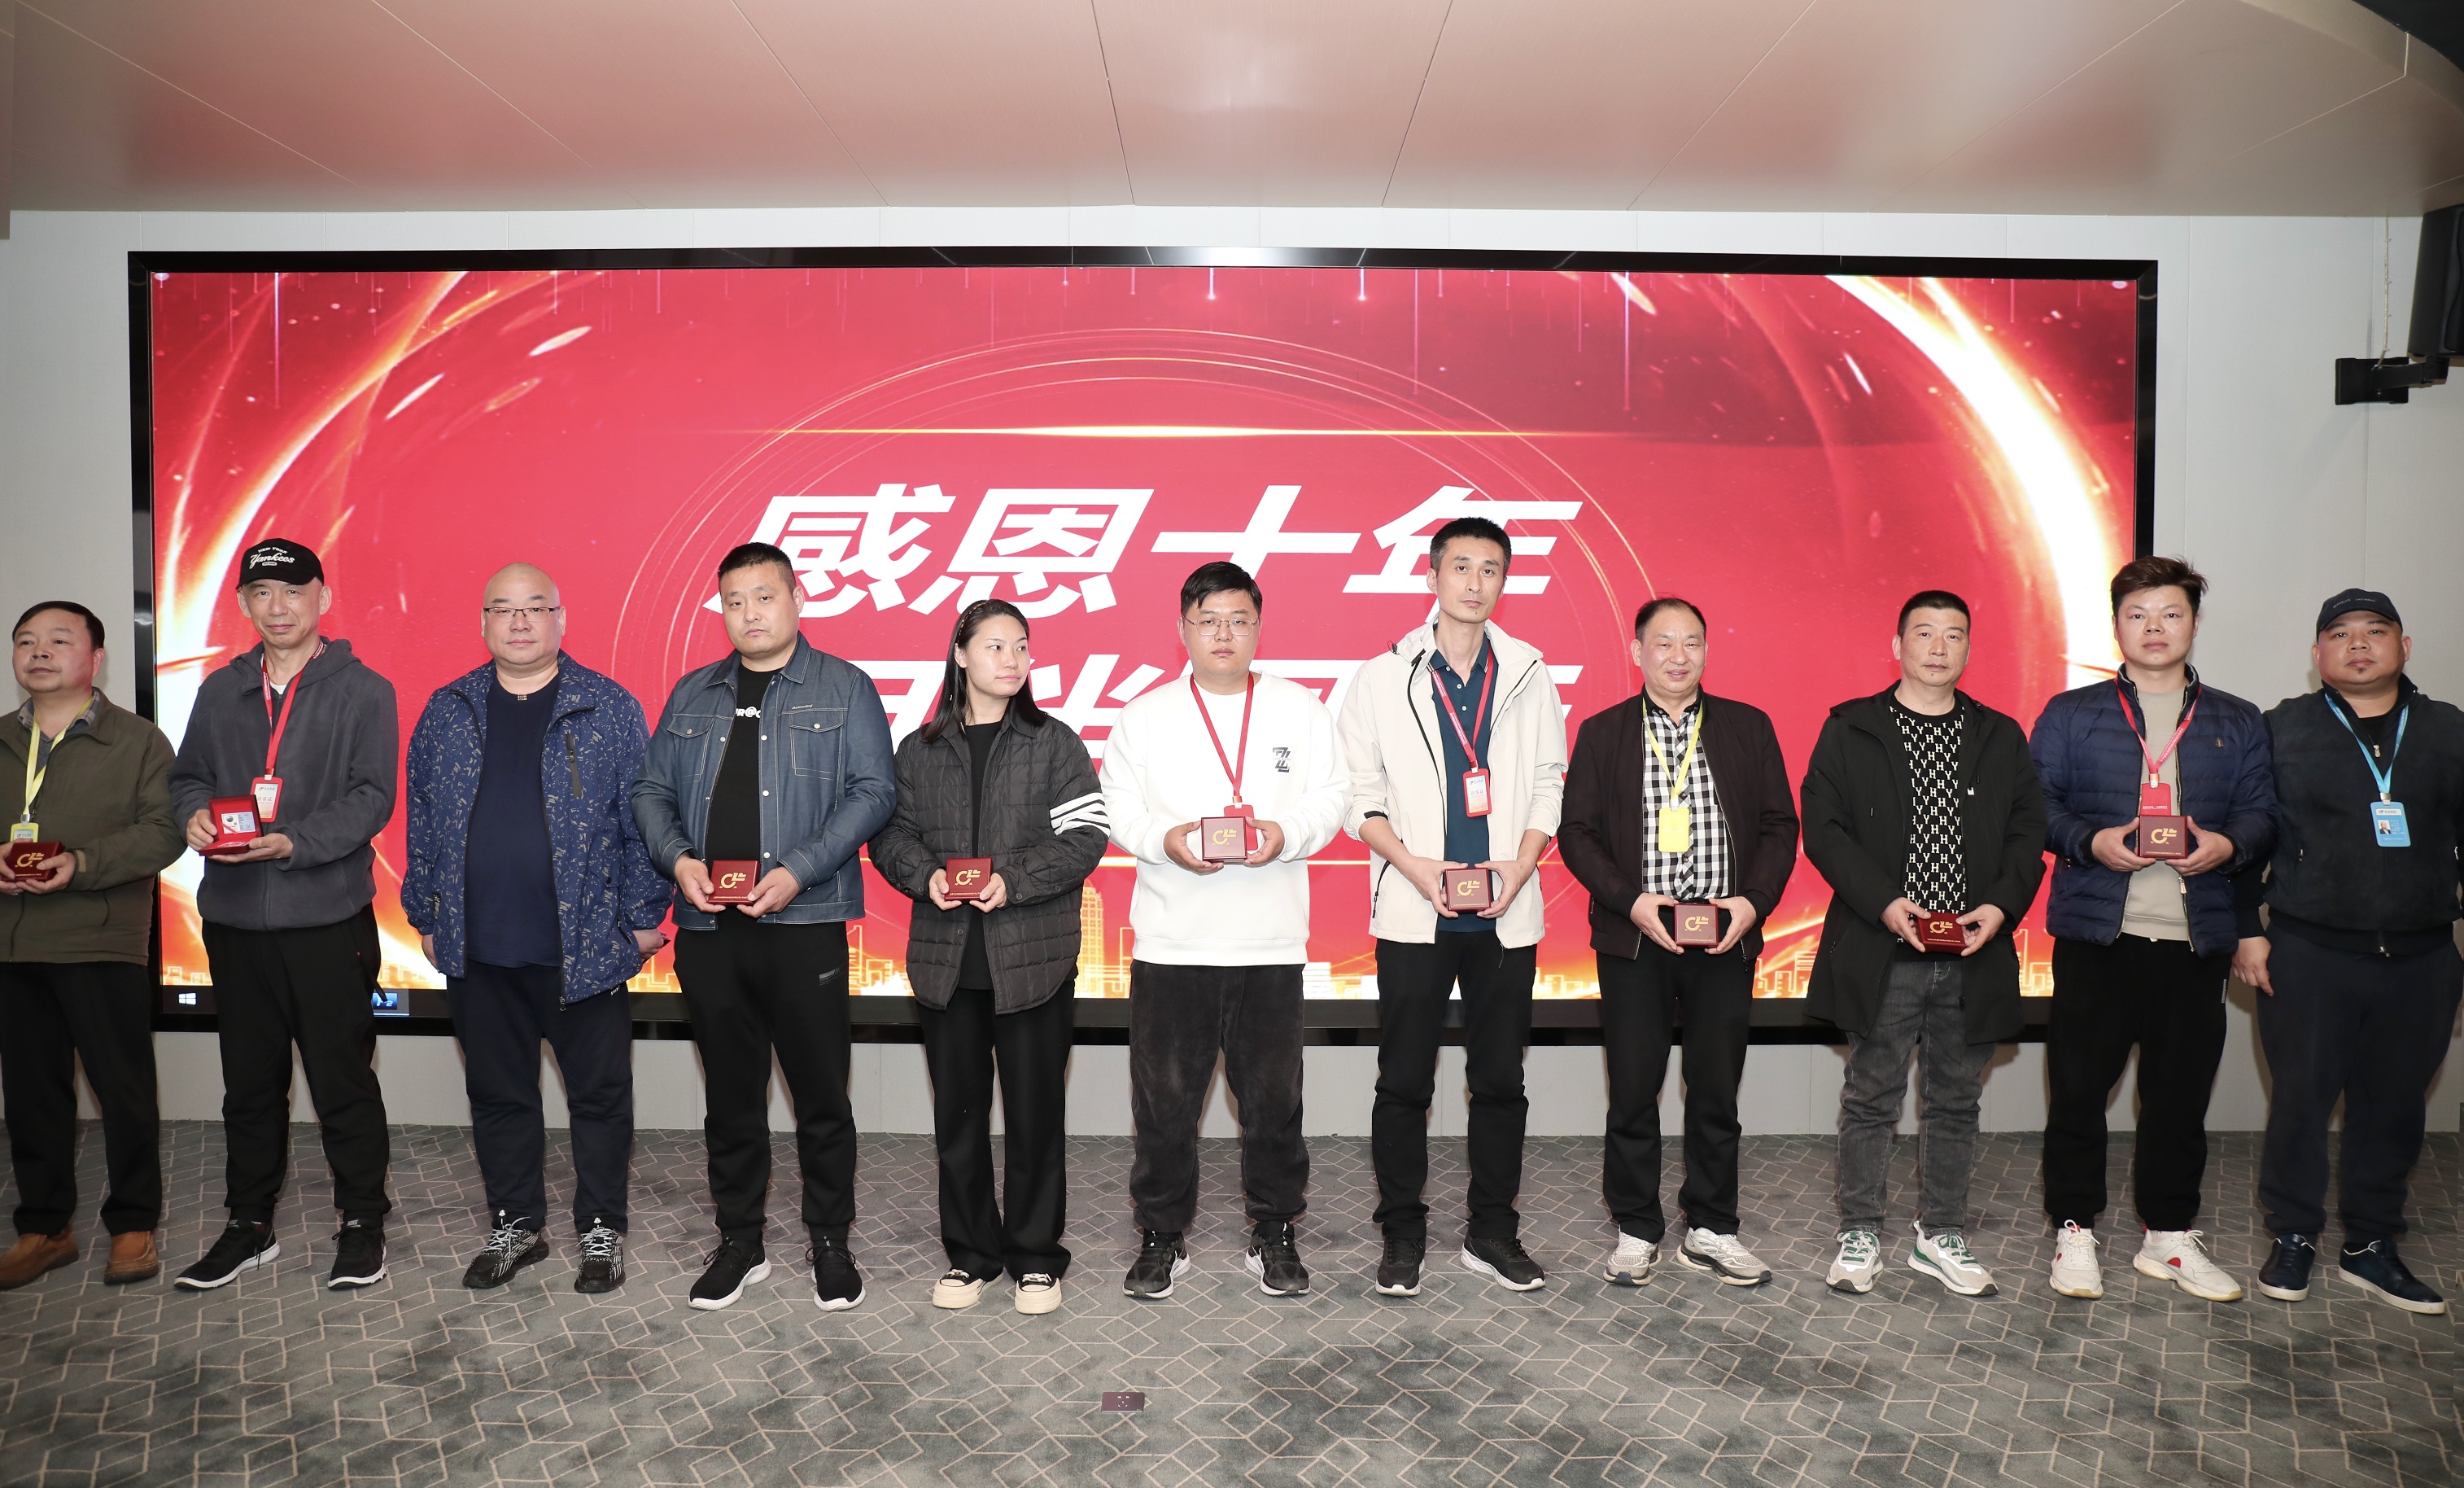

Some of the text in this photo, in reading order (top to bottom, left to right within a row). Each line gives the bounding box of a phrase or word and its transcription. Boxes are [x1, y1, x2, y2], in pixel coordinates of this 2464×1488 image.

[249, 553, 295, 570] Yankees
[702, 484, 1583, 623] 感恩十年
